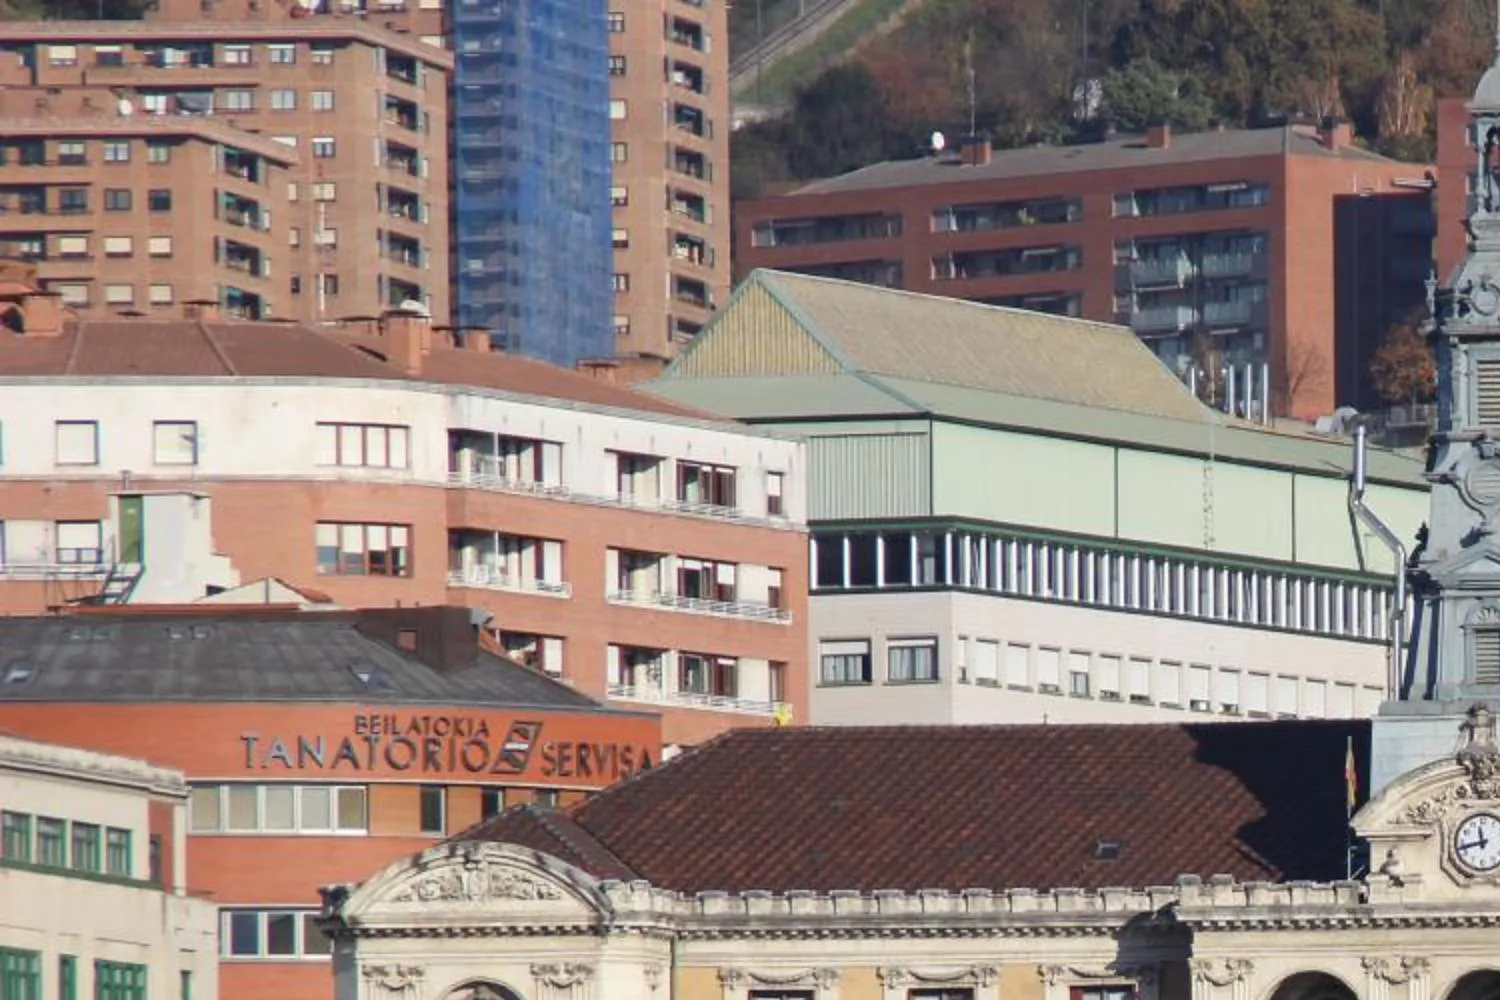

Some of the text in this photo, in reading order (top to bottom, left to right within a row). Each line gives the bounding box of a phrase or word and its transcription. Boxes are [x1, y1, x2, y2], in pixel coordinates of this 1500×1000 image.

[354, 714, 490, 737] BEILATOKIA
[240, 735, 654, 778] TANATORIO SERVISA
